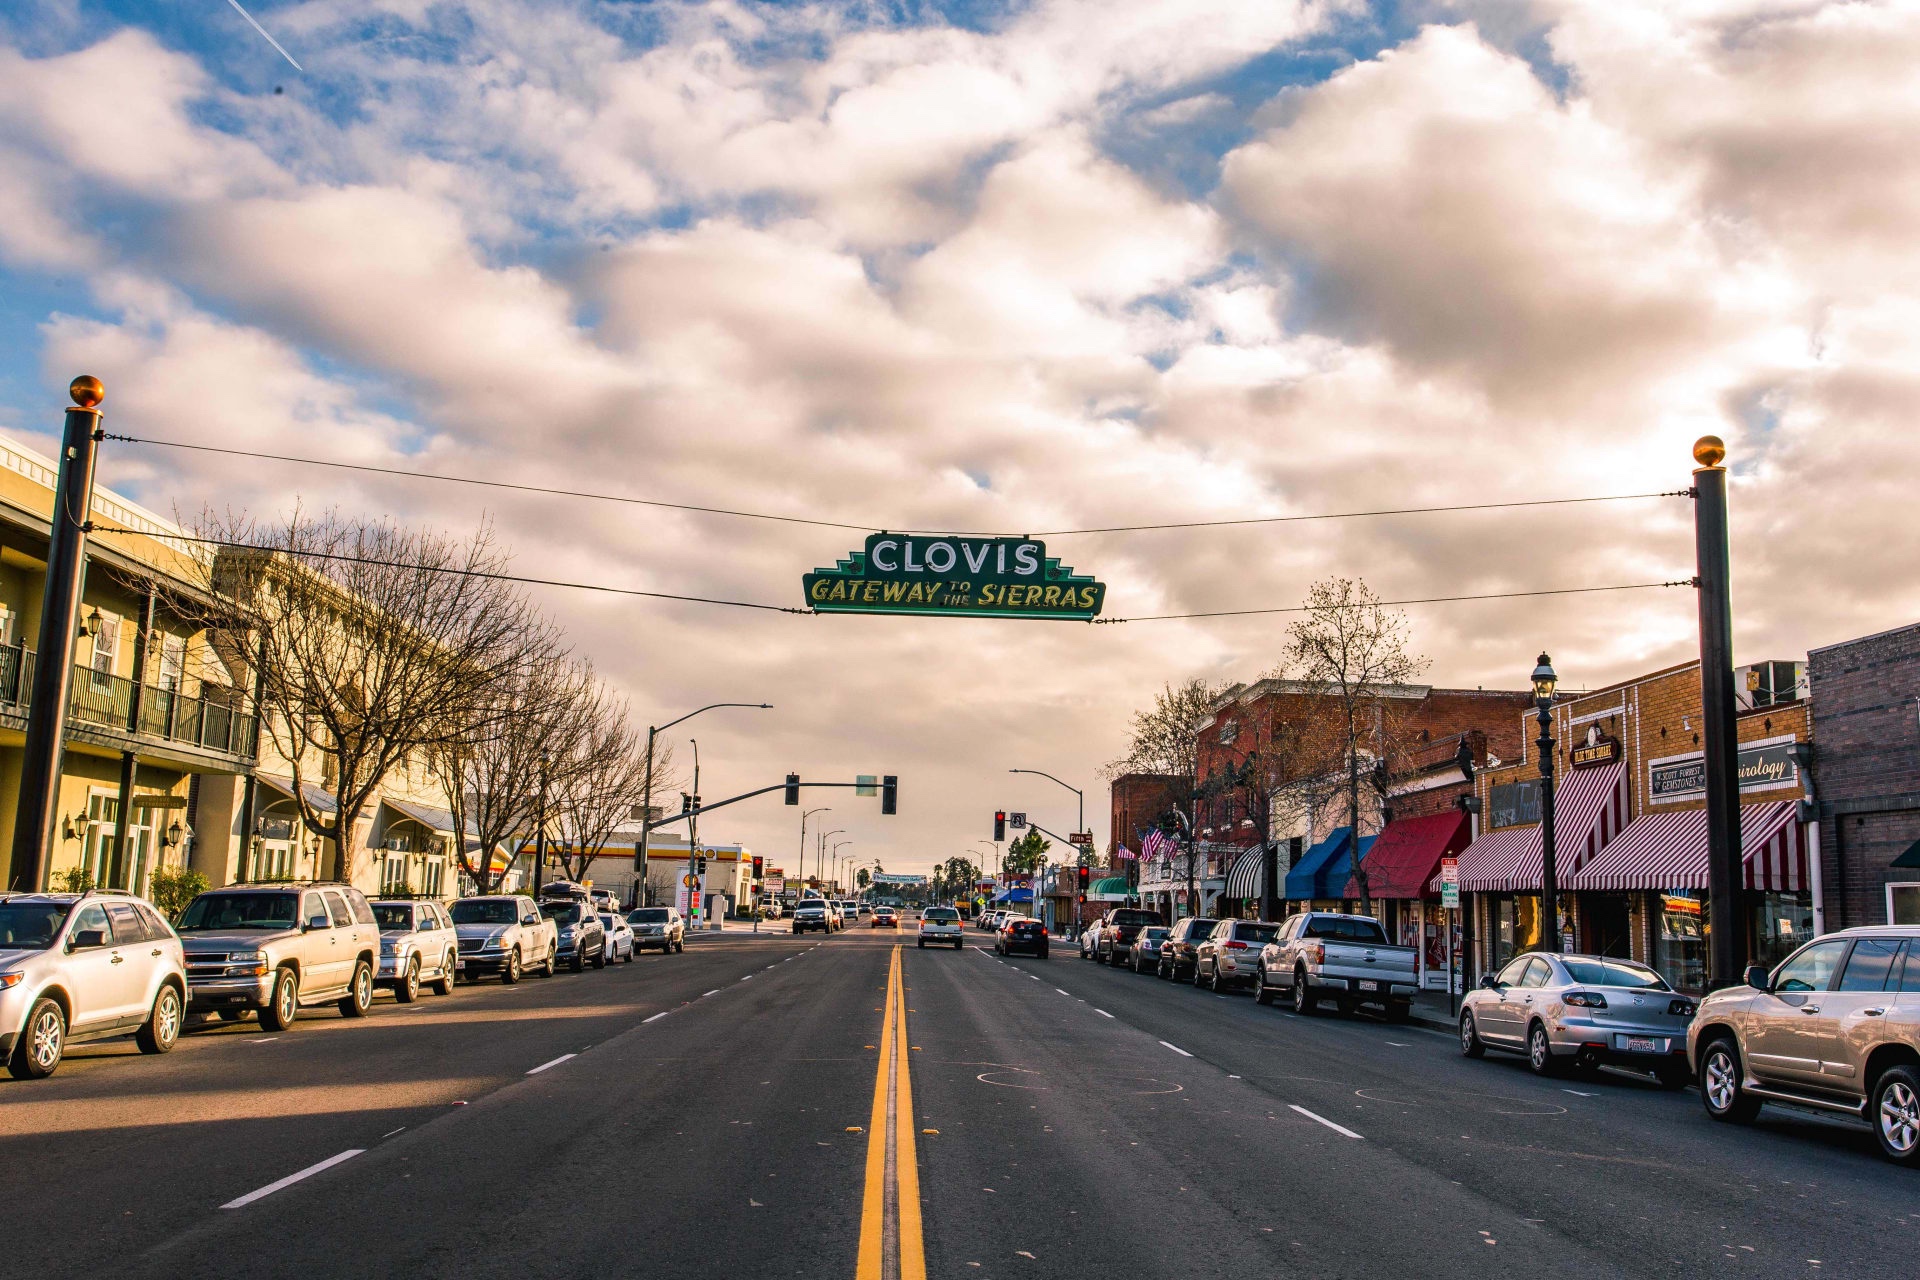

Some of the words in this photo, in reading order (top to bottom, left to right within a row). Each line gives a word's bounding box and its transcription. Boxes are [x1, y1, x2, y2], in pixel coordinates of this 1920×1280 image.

[872, 540, 1039, 575] CLOVIS
[811, 579, 942, 603] GATEWAY
[950, 581, 971, 593] TO
[943, 594, 970, 606] THE
[978, 584, 1098, 608] SIERRAS
[1596, 744, 1612, 758] SQUARE
[1680, 766, 1701, 778] FORREST
[1661, 776, 1697, 791] GEMSTONES
